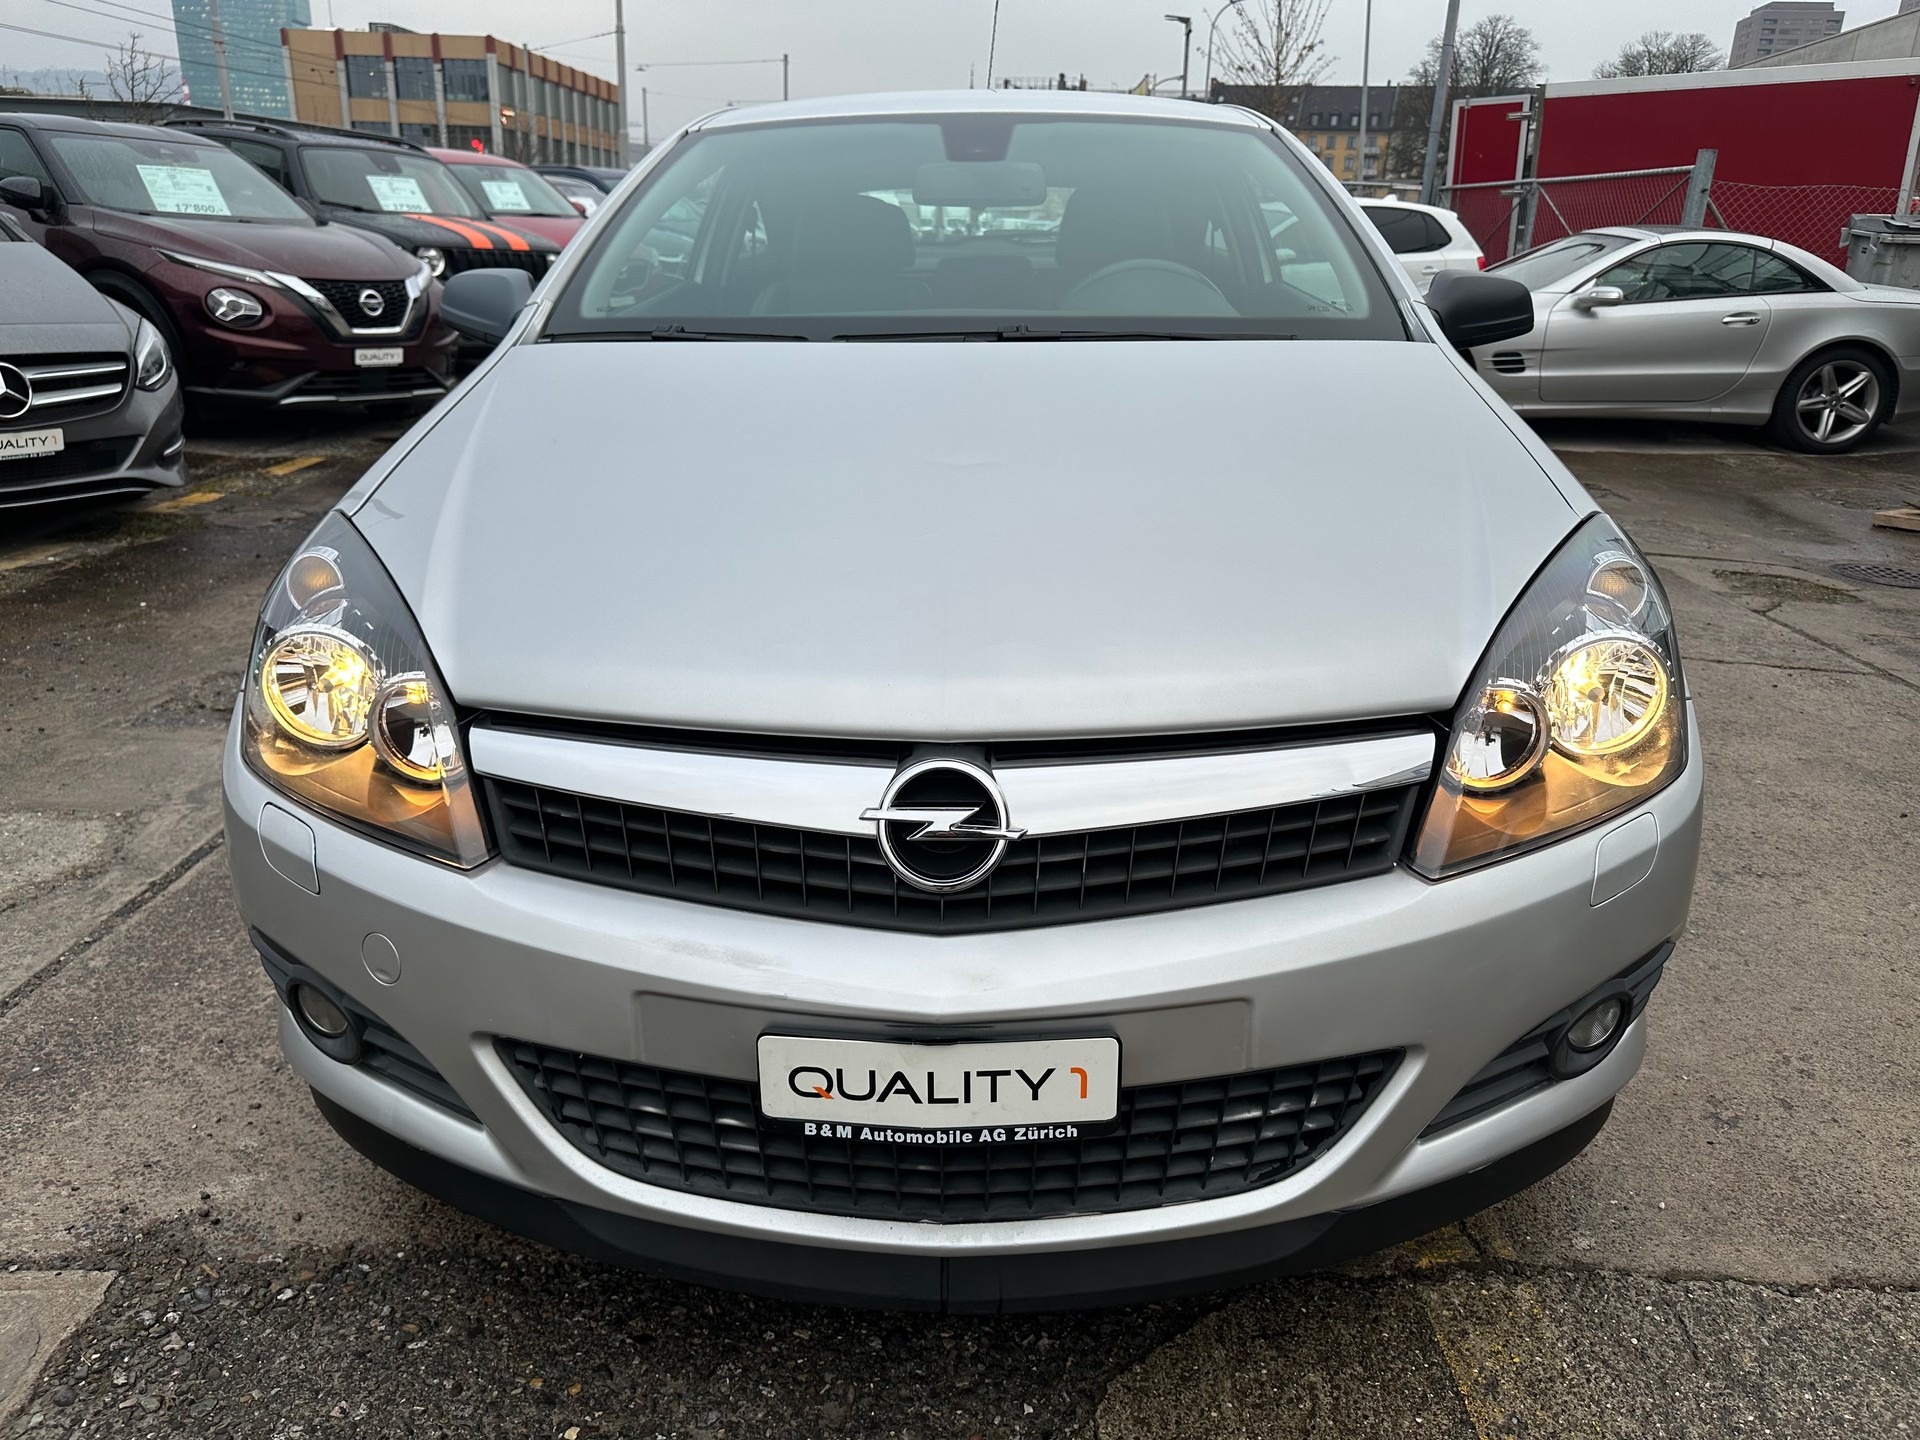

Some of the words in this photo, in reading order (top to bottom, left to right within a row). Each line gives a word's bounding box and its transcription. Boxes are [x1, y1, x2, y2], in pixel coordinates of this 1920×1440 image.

[51, 435, 57, 445] 1
[788, 1065, 1056, 1105] QUALITY
[1070, 1066, 1088, 1099] 1
[804, 1122, 852, 1139] B&M
[860, 1127, 973, 1144] Automobile
[978, 1128, 1007, 1143] AG
[1014, 1125, 1078, 1141] Zürich
